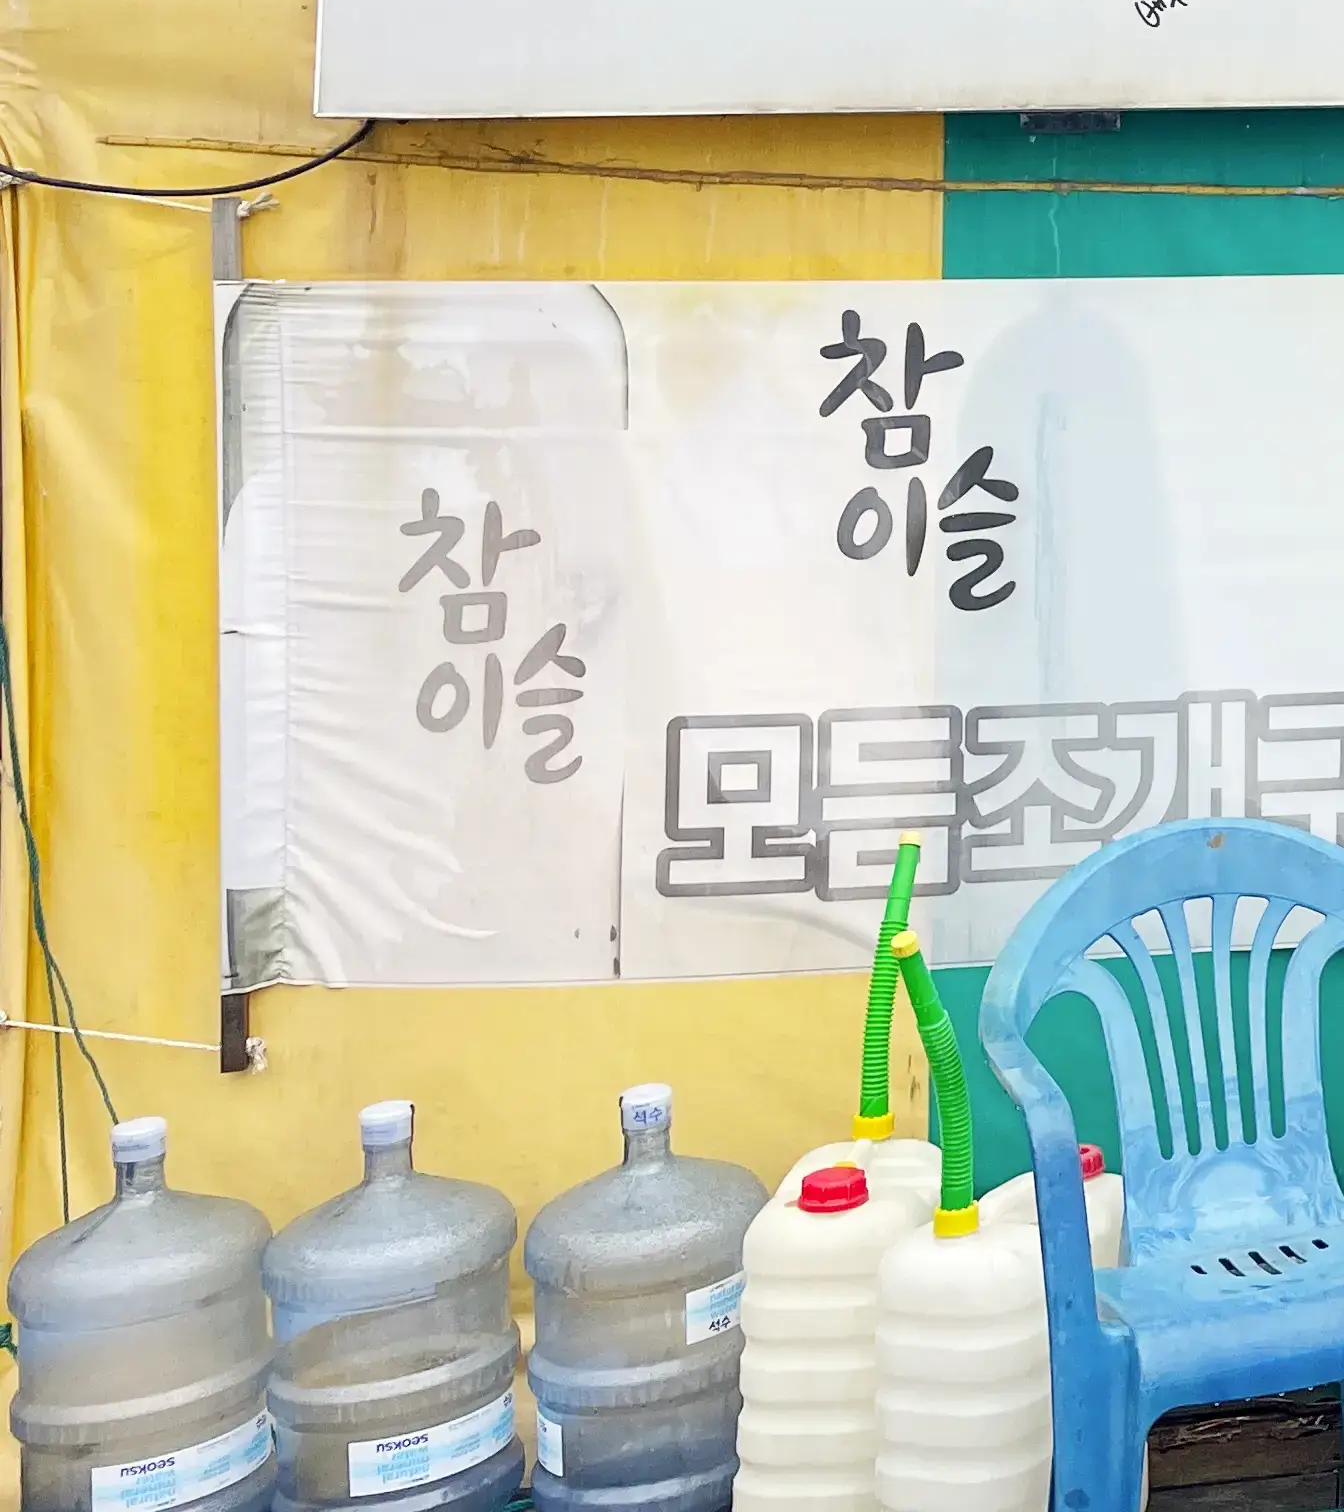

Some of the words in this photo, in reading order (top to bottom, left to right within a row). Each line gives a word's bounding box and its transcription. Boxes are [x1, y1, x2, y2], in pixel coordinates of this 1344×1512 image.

[818, 308, 965, 470] 참
[398, 487, 542, 645] 참
[836, 444, 1021, 612] 이슬
[415, 621, 587, 785] 이슬
[119, 1456, 176, 1478] seoksu
[375, 1432, 429, 1454] seoksu
